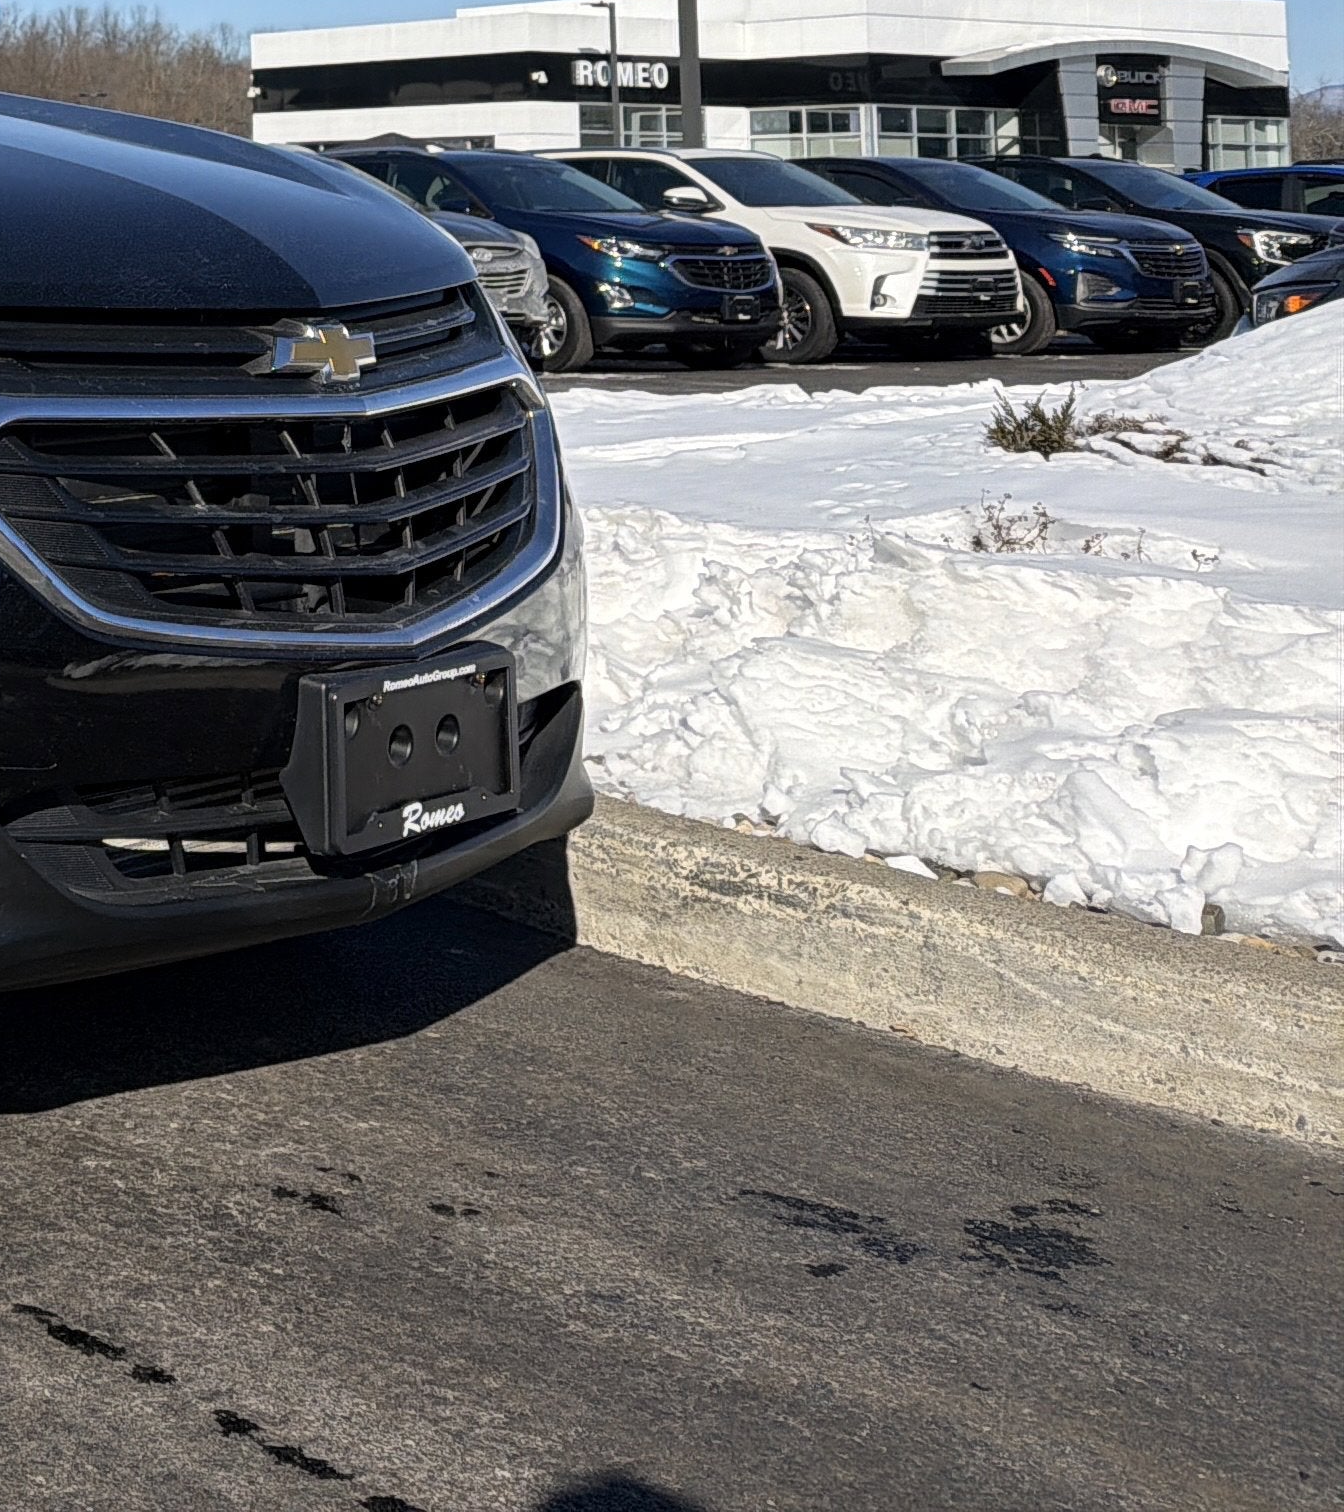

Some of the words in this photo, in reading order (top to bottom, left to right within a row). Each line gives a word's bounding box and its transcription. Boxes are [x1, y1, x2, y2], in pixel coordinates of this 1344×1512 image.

[574, 60, 669, 89] ROMEO
[1116, 70, 1163, 84] BUICK
[1110, 98, 1159, 115] GMC
[382, 663, 477, 693] RomeoAutoGroup.com
[402, 801, 465, 838] Romeo
